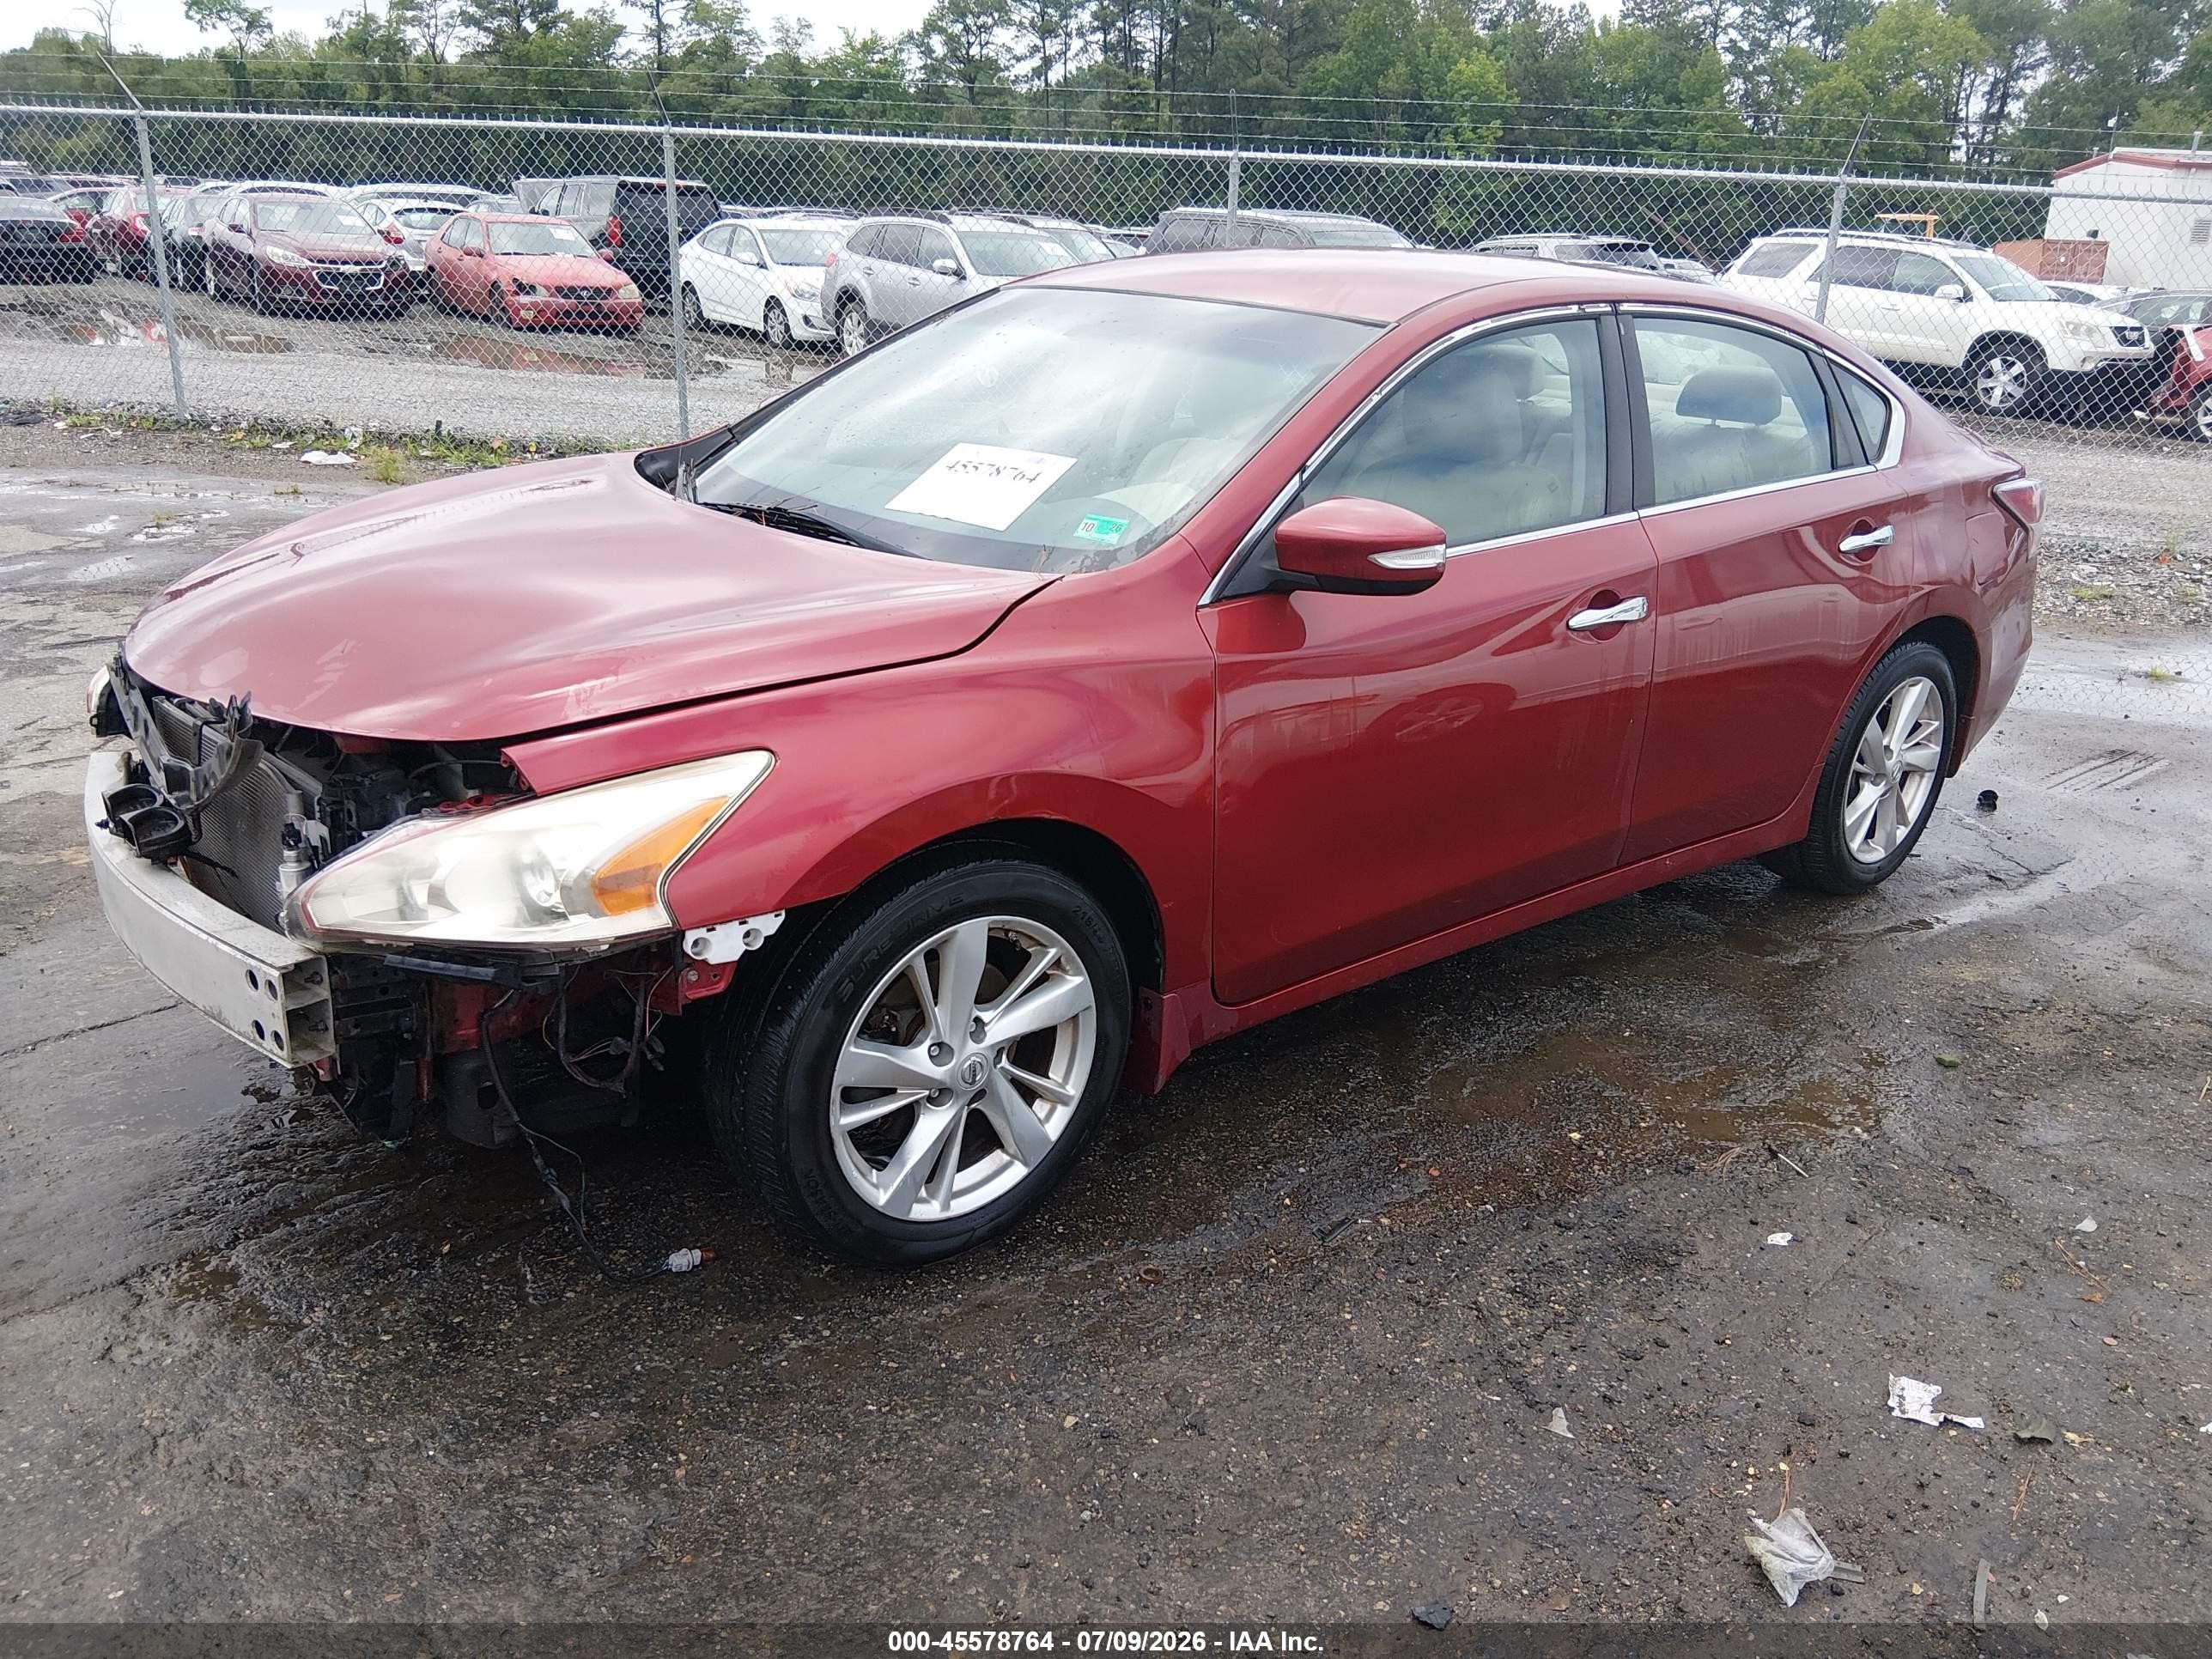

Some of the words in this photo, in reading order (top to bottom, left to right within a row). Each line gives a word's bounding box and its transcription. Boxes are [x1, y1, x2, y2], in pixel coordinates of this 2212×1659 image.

[1080, 521, 1096, 532] 10
[1109, 522, 1124, 532] 26
[836, 934, 894, 1003] SURE
